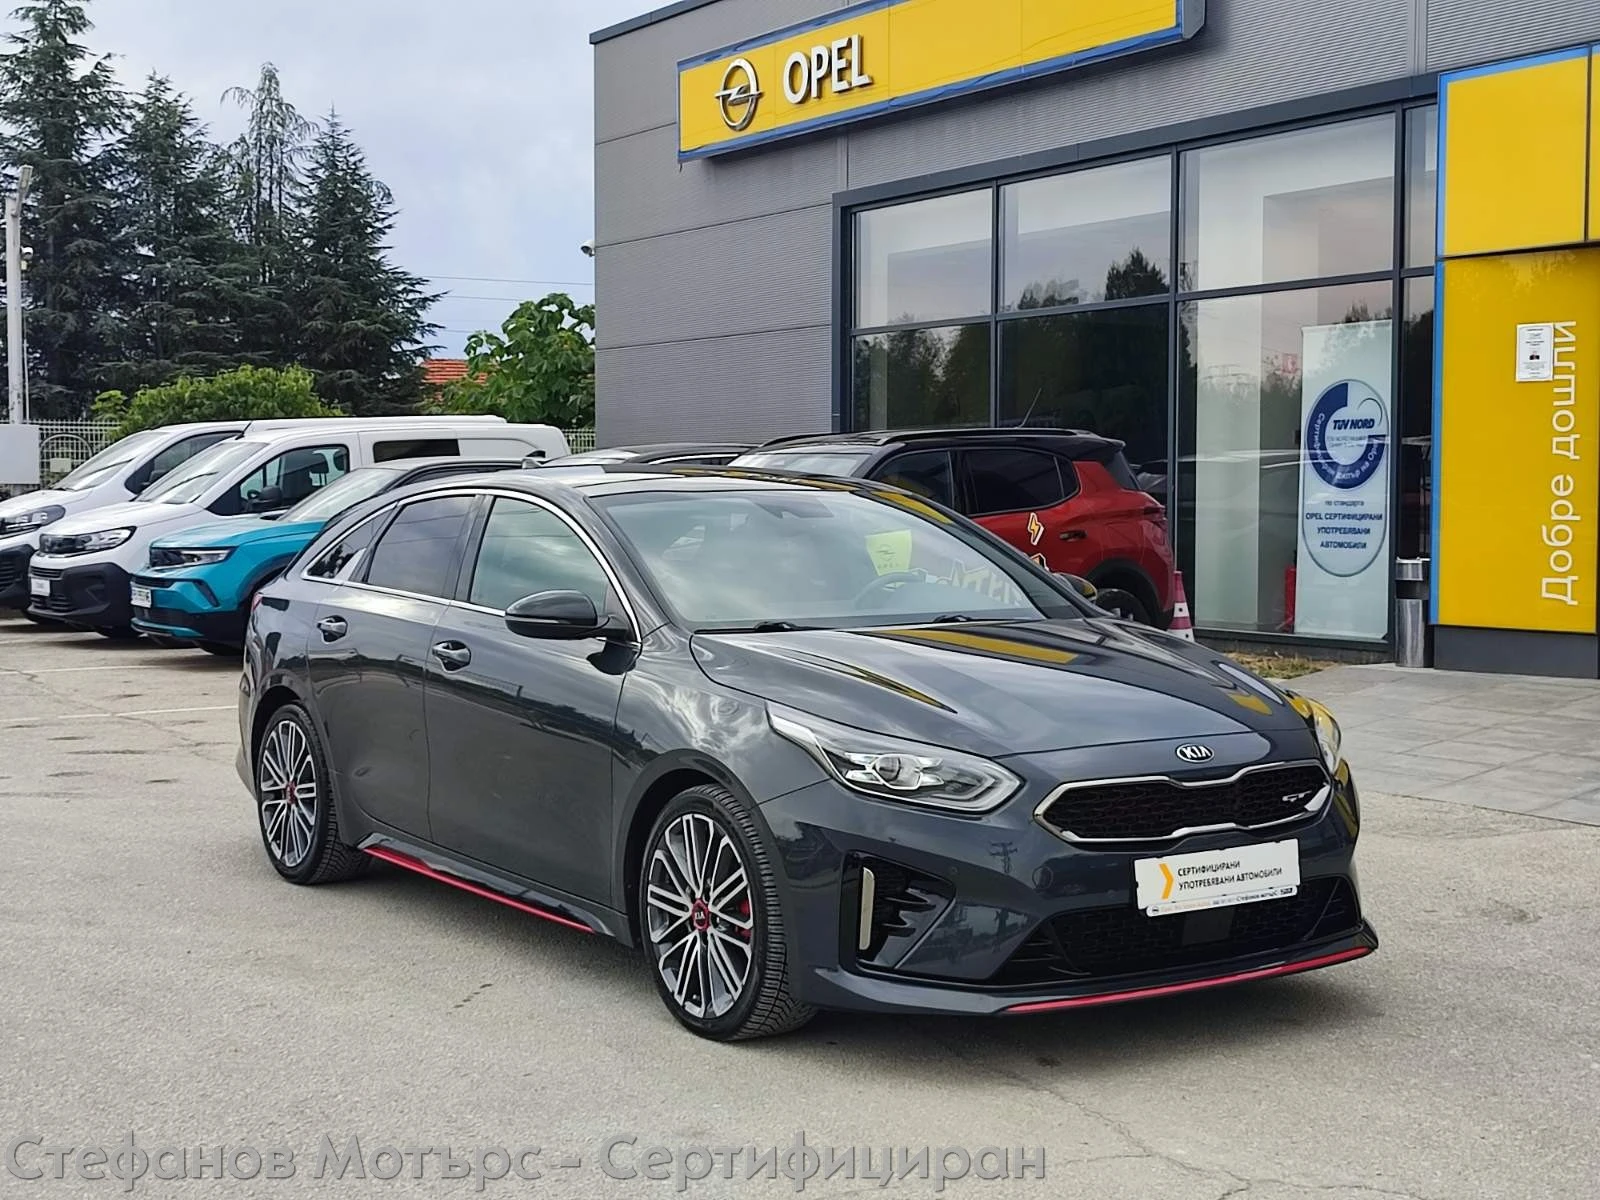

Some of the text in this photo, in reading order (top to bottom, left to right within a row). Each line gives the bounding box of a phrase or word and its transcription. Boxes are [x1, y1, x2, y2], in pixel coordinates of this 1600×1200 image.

[783, 34, 872, 104] OPEL
[1350, 419, 1374, 430] NORD
[1541, 321, 1581, 606] Добре дошли
[1305, 512, 1383, 522] OPEL СЕРТИФИЦИРАНИ
[1317, 526, 1371, 535] УПОТРЕБЯВАНИ
[1320, 541, 1367, 549] АВТОМОБИЛИ
[1181, 746, 1212, 759] KIA
[1178, 860, 1240, 877] СЕРТИФИЦИРАНИ
[1179, 867, 1282, 891] УПОТРЕБЯВАНИ АВТОМОБИЛИ
